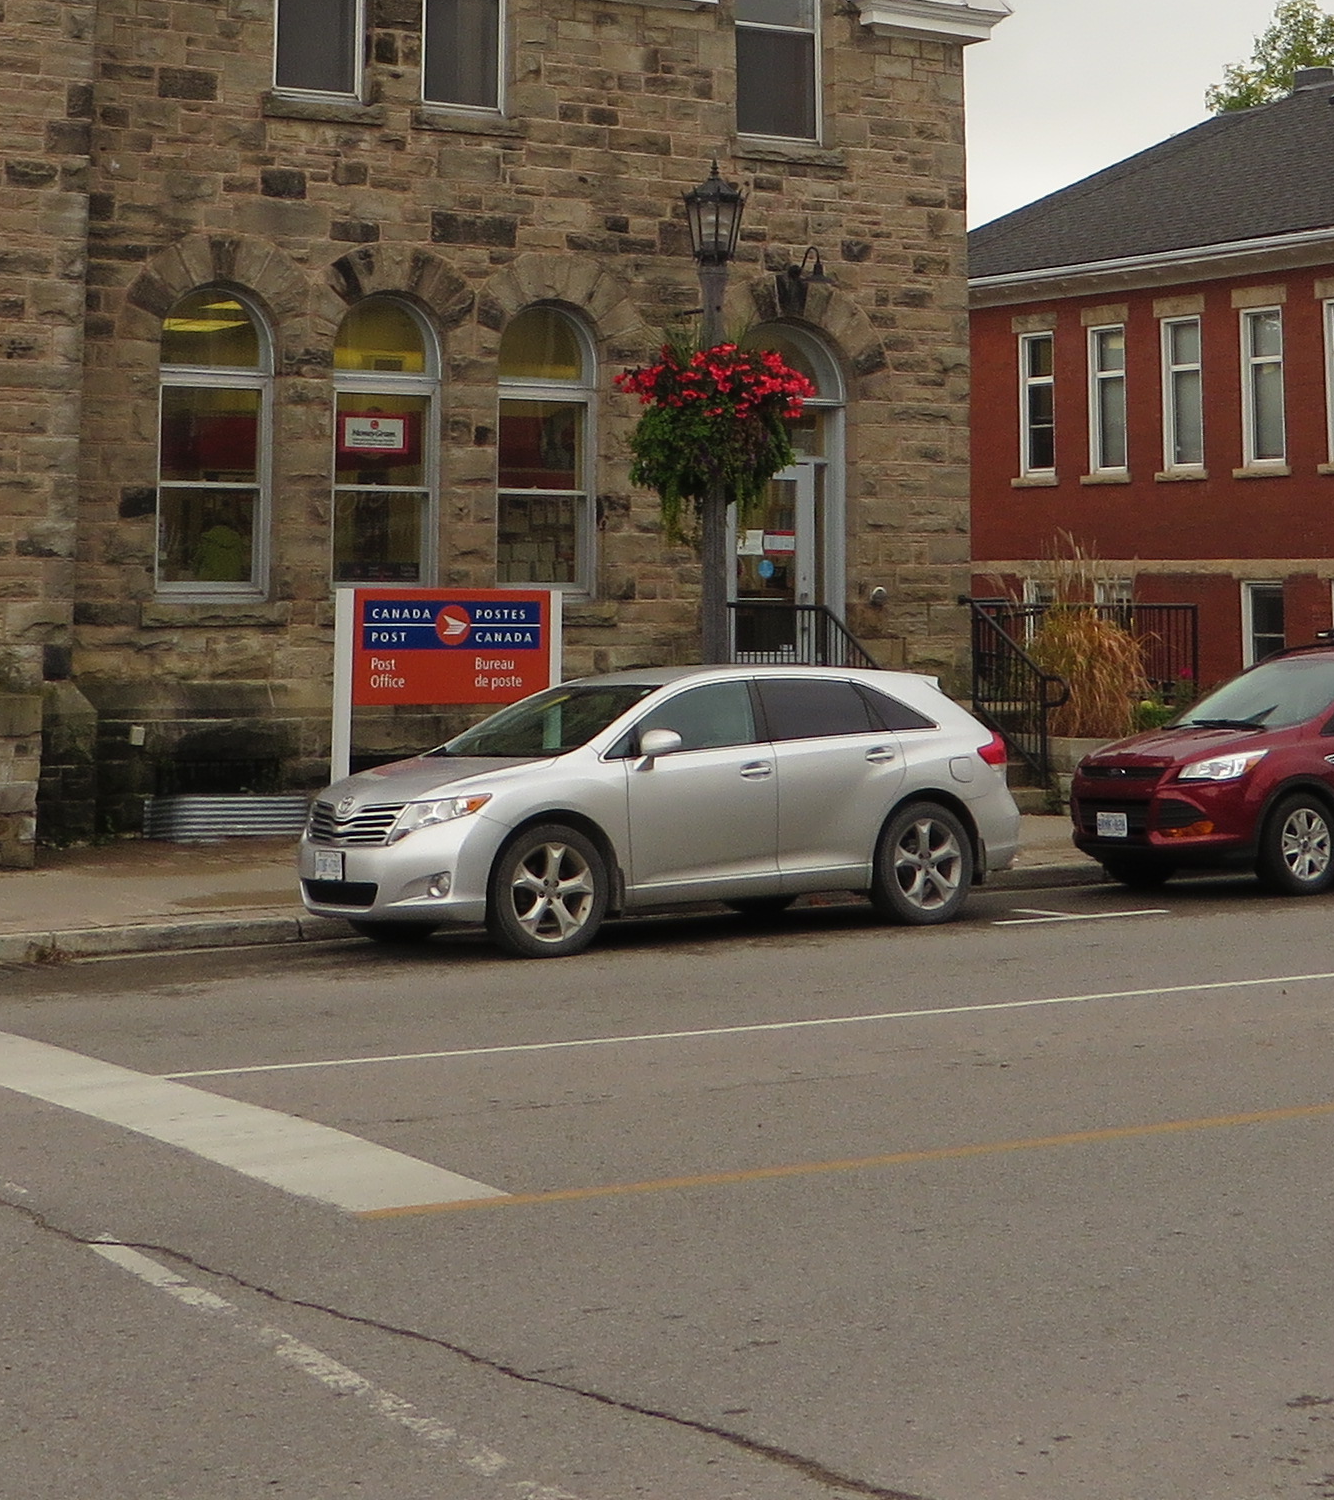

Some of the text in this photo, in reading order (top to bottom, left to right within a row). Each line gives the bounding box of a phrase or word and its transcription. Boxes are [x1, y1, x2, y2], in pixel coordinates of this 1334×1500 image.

[372, 608, 432, 619] CANADA
[475, 609, 526, 620] POSTES
[371, 632, 407, 643] POST
[475, 632, 533, 643] CANADA
[371, 657, 396, 671] Post
[475, 657, 515, 670] Bureau
[370, 674, 406, 688] Office
[474, 674, 523, 690] de poste
